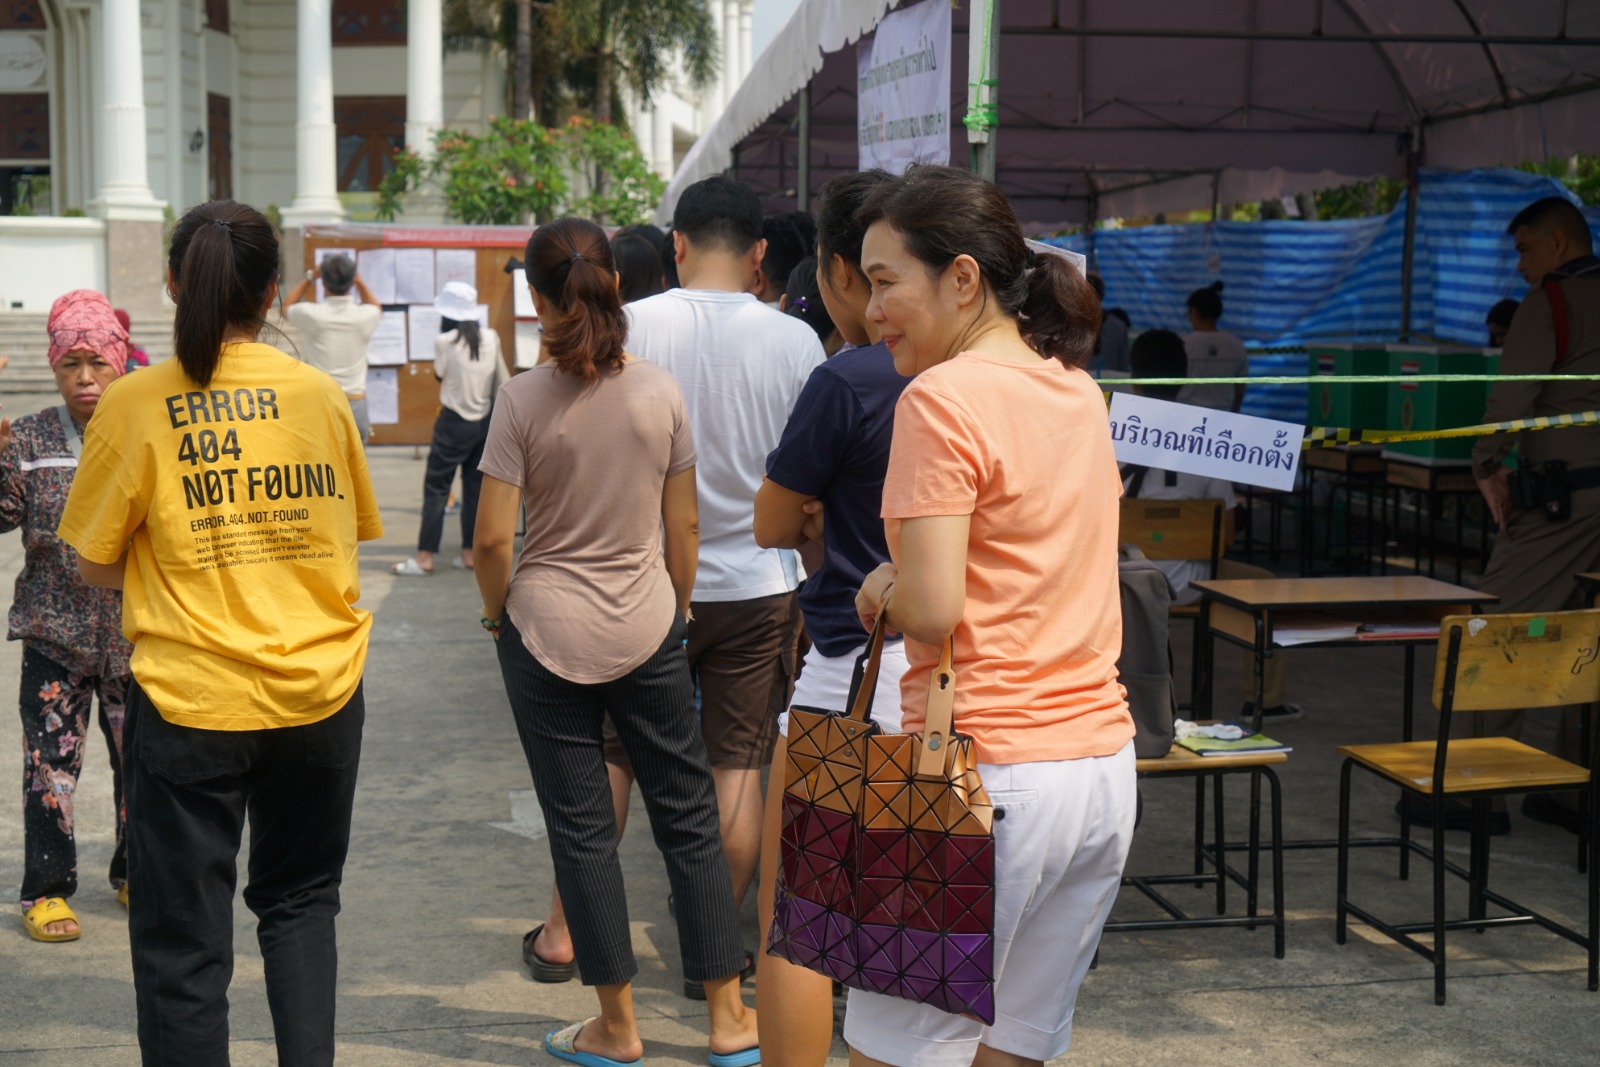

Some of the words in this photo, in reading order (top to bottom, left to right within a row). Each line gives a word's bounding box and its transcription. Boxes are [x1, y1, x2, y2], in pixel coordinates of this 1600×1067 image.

[165, 388, 280, 429] ERROR
[178, 427, 242, 466] 404
[1109, 414, 1294, 471] บริเวณที่เลือกตั้ง
[194, 536, 210, 545] This
[247, 528, 278, 536] message
[296, 526, 313, 534] your
[195, 545, 211, 554] web
[265, 537, 279, 545] that
[197, 553, 219, 564] trying
[224, 550, 234, 558] be
[260, 545, 286, 554] doesn't
